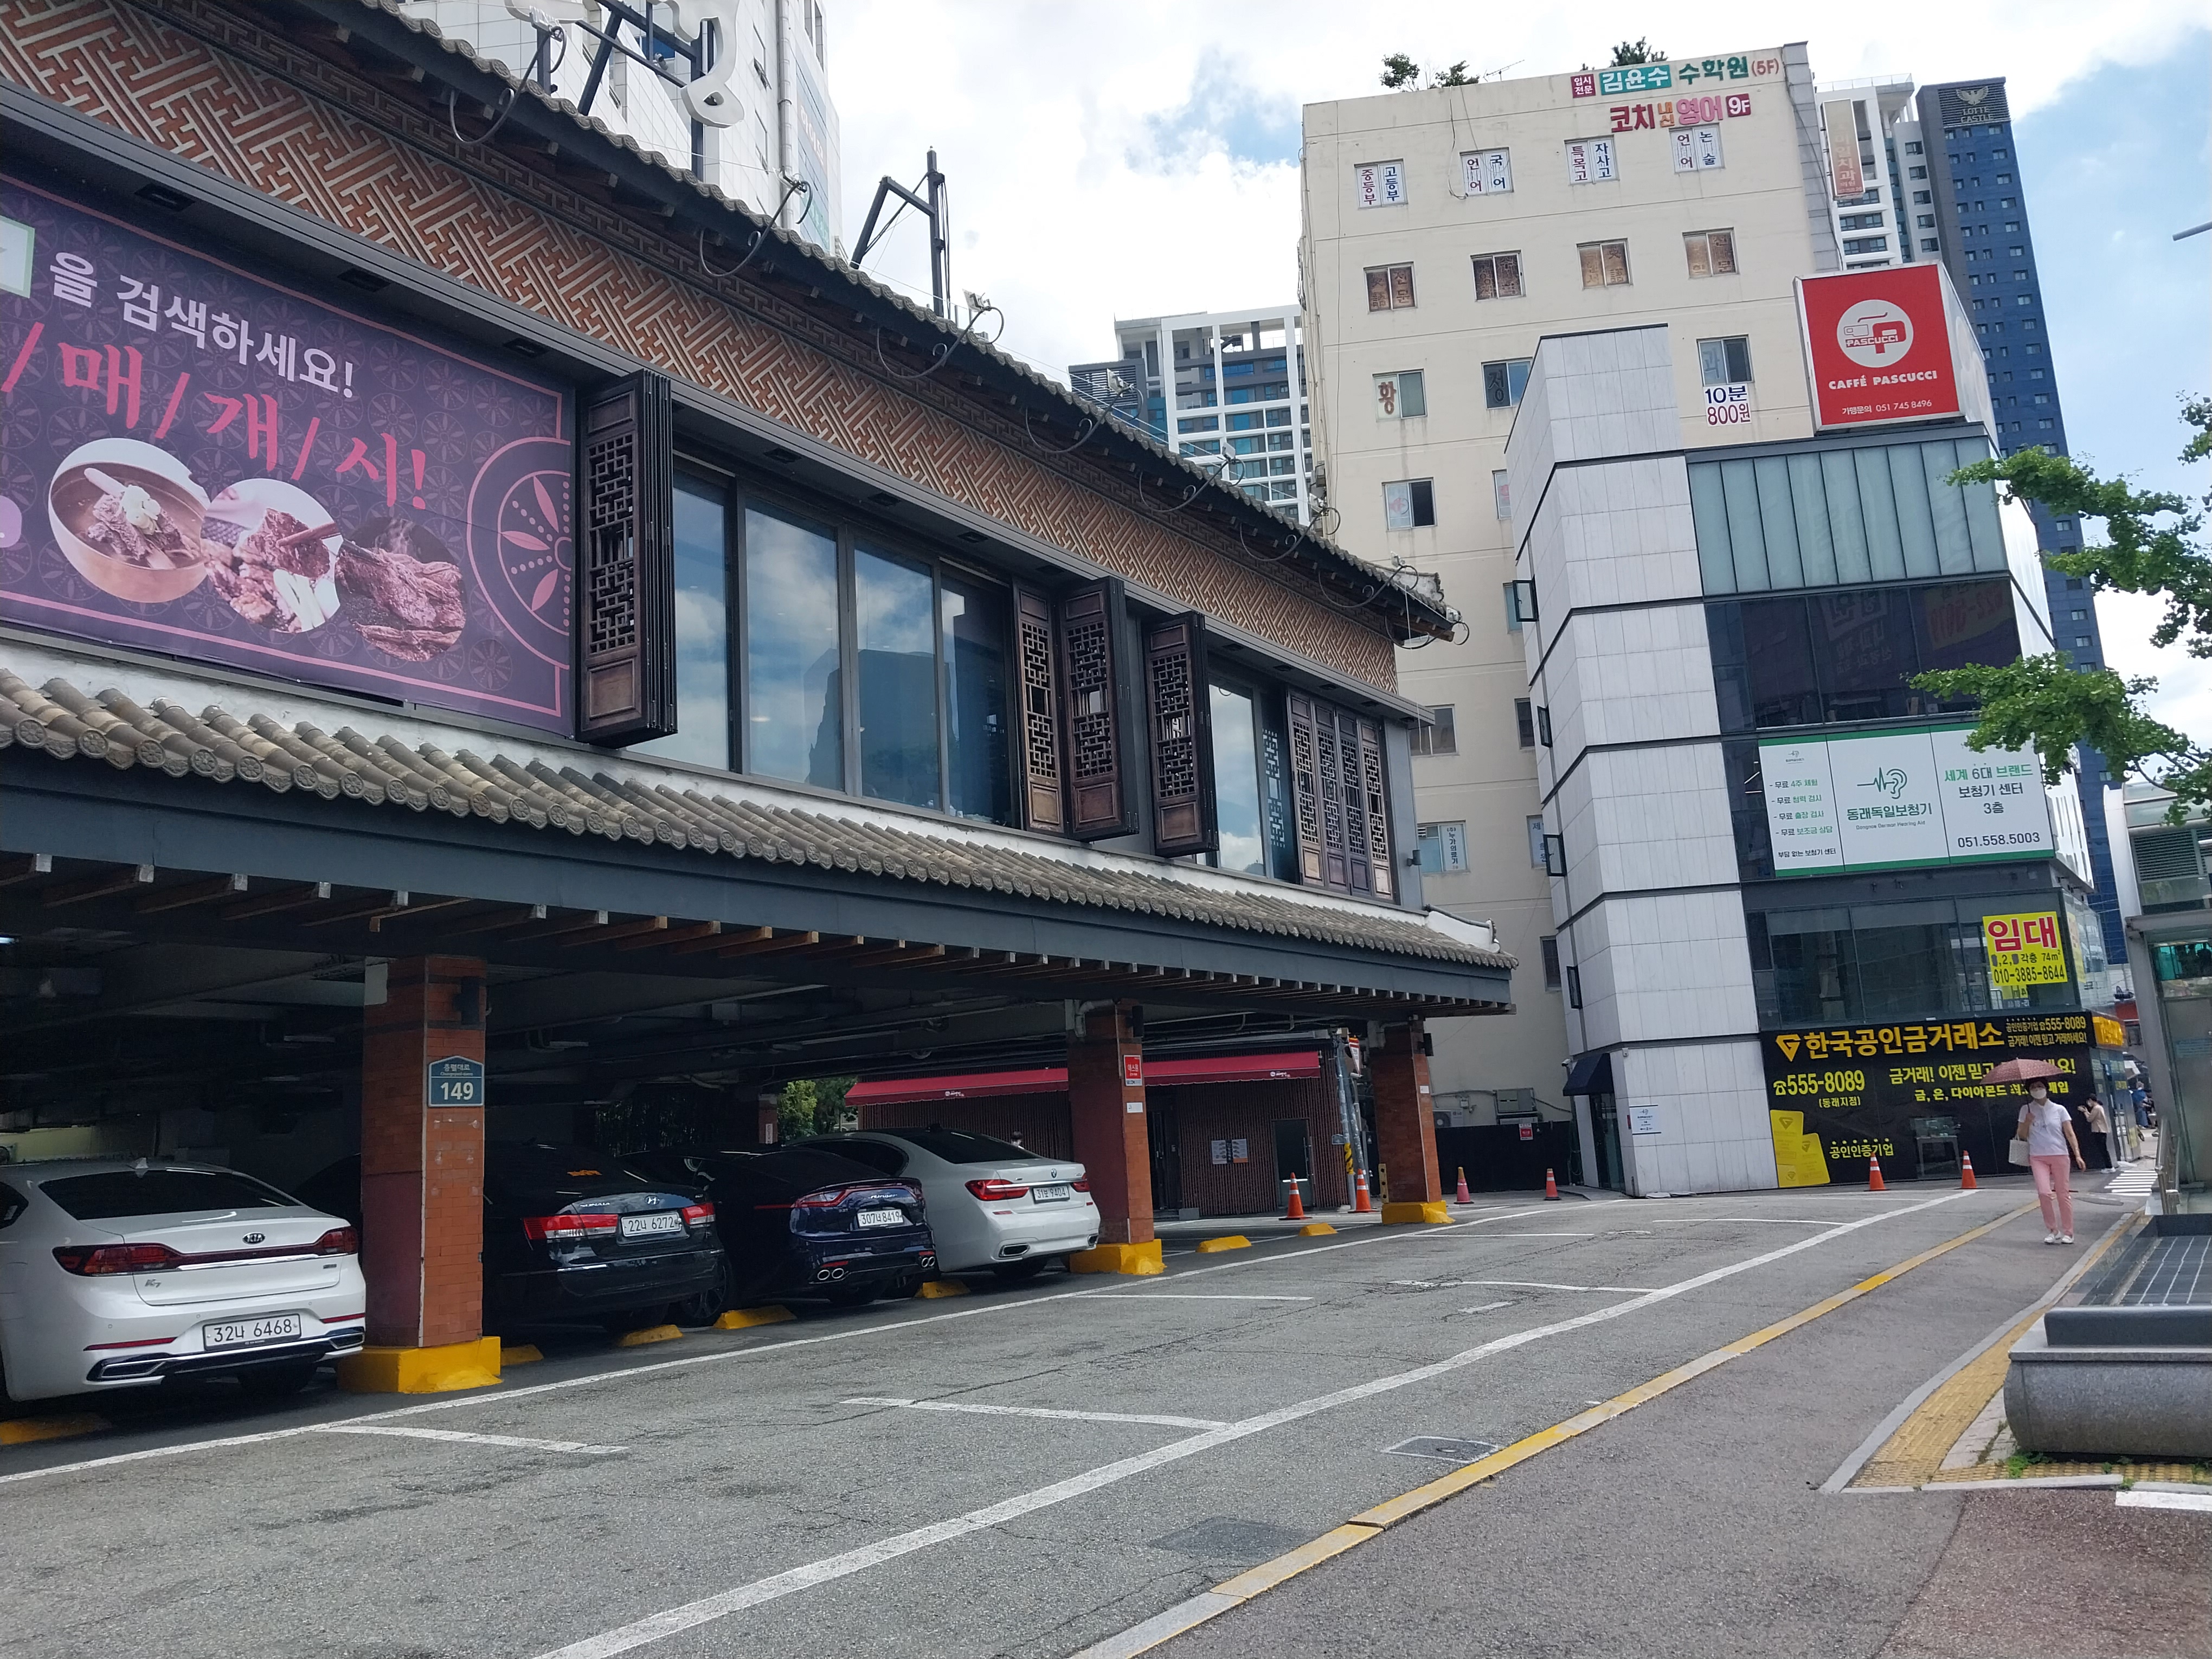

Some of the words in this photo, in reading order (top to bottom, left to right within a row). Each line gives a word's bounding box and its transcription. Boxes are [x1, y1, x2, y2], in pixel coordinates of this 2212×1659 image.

[1573, 76, 1592, 86] 입시
[1602, 67, 1669, 92] 김윤수
[1679, 56, 1749, 85] 수학원
[1751, 58, 1779, 77] (5F)
[1574, 85, 1593, 95] 전문
[1610, 103, 1655, 132] 코치
[1676, 95, 1723, 125] 영어
[1728, 97, 1751, 115] 9F
[1961, 114, 1995, 124] CASTLE
[1963, 106, 1991, 115] LOTTE
[1677, 133, 1694, 169] 언어
[1699, 132, 1716, 166] 논술
[1571, 145, 1588, 182] 특목고
[1595, 143, 1612, 178] 자사고
[1467, 158, 1483, 192] 언어
[1490, 155, 1507, 190] 국어
[1361, 169, 1377, 205] 중등부
[1384, 166, 1400, 202] 고등부
[50, 251, 98, 307] 을
[116, 274, 355, 398] 검색하세요!
[1846, 335, 1899, 348] PASCUCCI
[1873, 370, 1938, 386] PASCUCCI
[1705, 384, 1748, 404] 10분
[1707, 402, 1752, 426] 800원
[1842, 405, 1873, 415] 가맹문의
[1876, 403, 1891, 412] 051
[1894, 402, 1909, 410] 745
[1911, 399, 1932, 409] 8496
[1944, 769, 1969, 782] 세계
[1972, 766, 1992, 780] 6대
[1996, 763, 2034, 777] 브랜드
[1774, 781, 1789, 789] 무료
[1804, 779, 1818, 787] 체험
[1959, 784, 1995, 799] 보청기
[1998, 782, 2023, 796] 센터
[1777, 796, 1791, 805] 무료
[1808, 794, 1822, 802] 검사
[1983, 801, 2004, 814] 3층
[1779, 812, 1793, 820] 무료
[1810, 810, 1824, 818] 검사
[1847, 802, 1932, 821] 동래독일보청기
[1781, 828, 1795, 836] 무료
[1797, 827, 1818, 835] 보조금
[1819, 825, 1833, 834] 상담
[1449, 832, 1458, 864] 누가의료기
[1957, 832, 2041, 848] 051.558.5003
[1988, 916, 2058, 953] 임대
[2021, 952, 2037, 963] 각층
[1994, 964, 2065, 983] 010-3885-8644
[2006, 1021, 2039, 1033] 공인인증기업
[2044, 1016, 2086, 1031] 555-8089
[1804, 1021, 2005, 1059] 한국공인금거래소
[2008, 1034, 2029, 1047] 금거래!
[2029, 1034, 2042, 1046] 이젠
[2042, 1033, 2055, 1046] 믿고
[2054, 1032, 2087, 1045] 거래하세요!
[443, 1063, 471, 1072] 충렬대로
[1889, 1065, 1935, 1085] 금거래!
[1938, 1063, 1966, 1082] 이젠
[440, 1082, 474, 1100] 149
[1787, 1069, 1866, 1096] 555-8089
[1914, 1089, 1931, 1102] 금,
[1933, 1088, 1949, 1102] 은,
[1951, 1084, 2008, 1098] 다이아몬드
[1818, 1096, 1861, 1108] (동래지점)
[1829, 1143, 1894, 1159] 공인인증기업
[1050, 1186, 1066, 1197] 9404
[651, 1216, 675, 1230] 6272
[882, 1211, 900, 1223] 8419
[145, 1278, 162, 1289] K7
[253, 1319, 292, 1338] 6468
